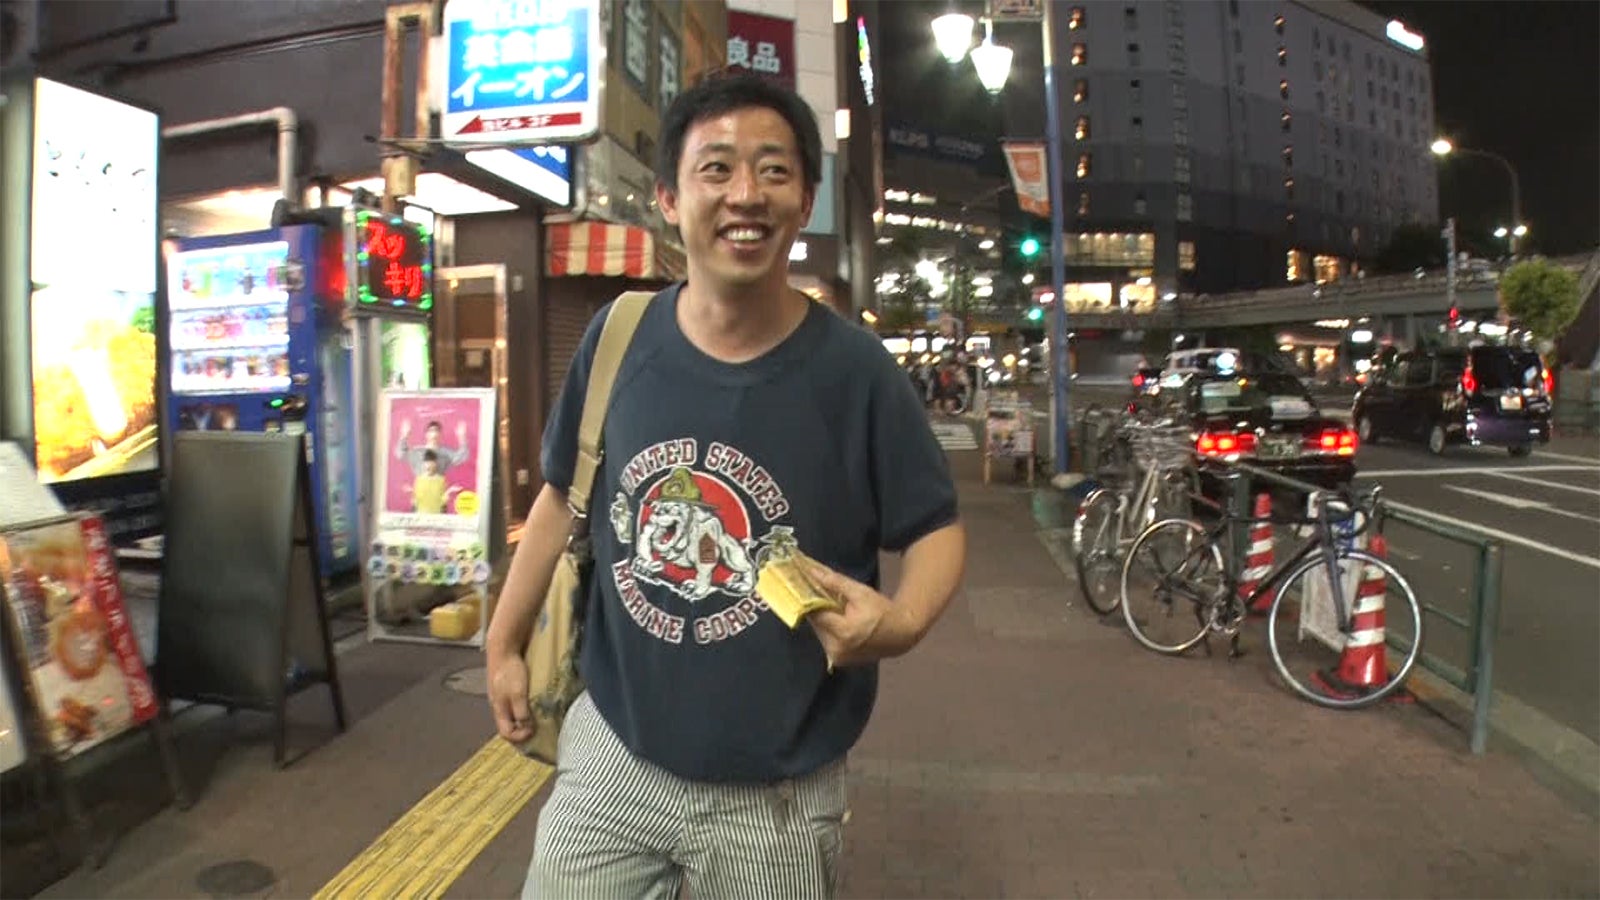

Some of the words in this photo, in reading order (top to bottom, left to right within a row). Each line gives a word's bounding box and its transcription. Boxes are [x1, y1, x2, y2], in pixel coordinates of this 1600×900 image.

[452, 66, 585, 107] イーオン
[619, 437, 698, 496] UNITED
[704, 441, 790, 522] STATES
